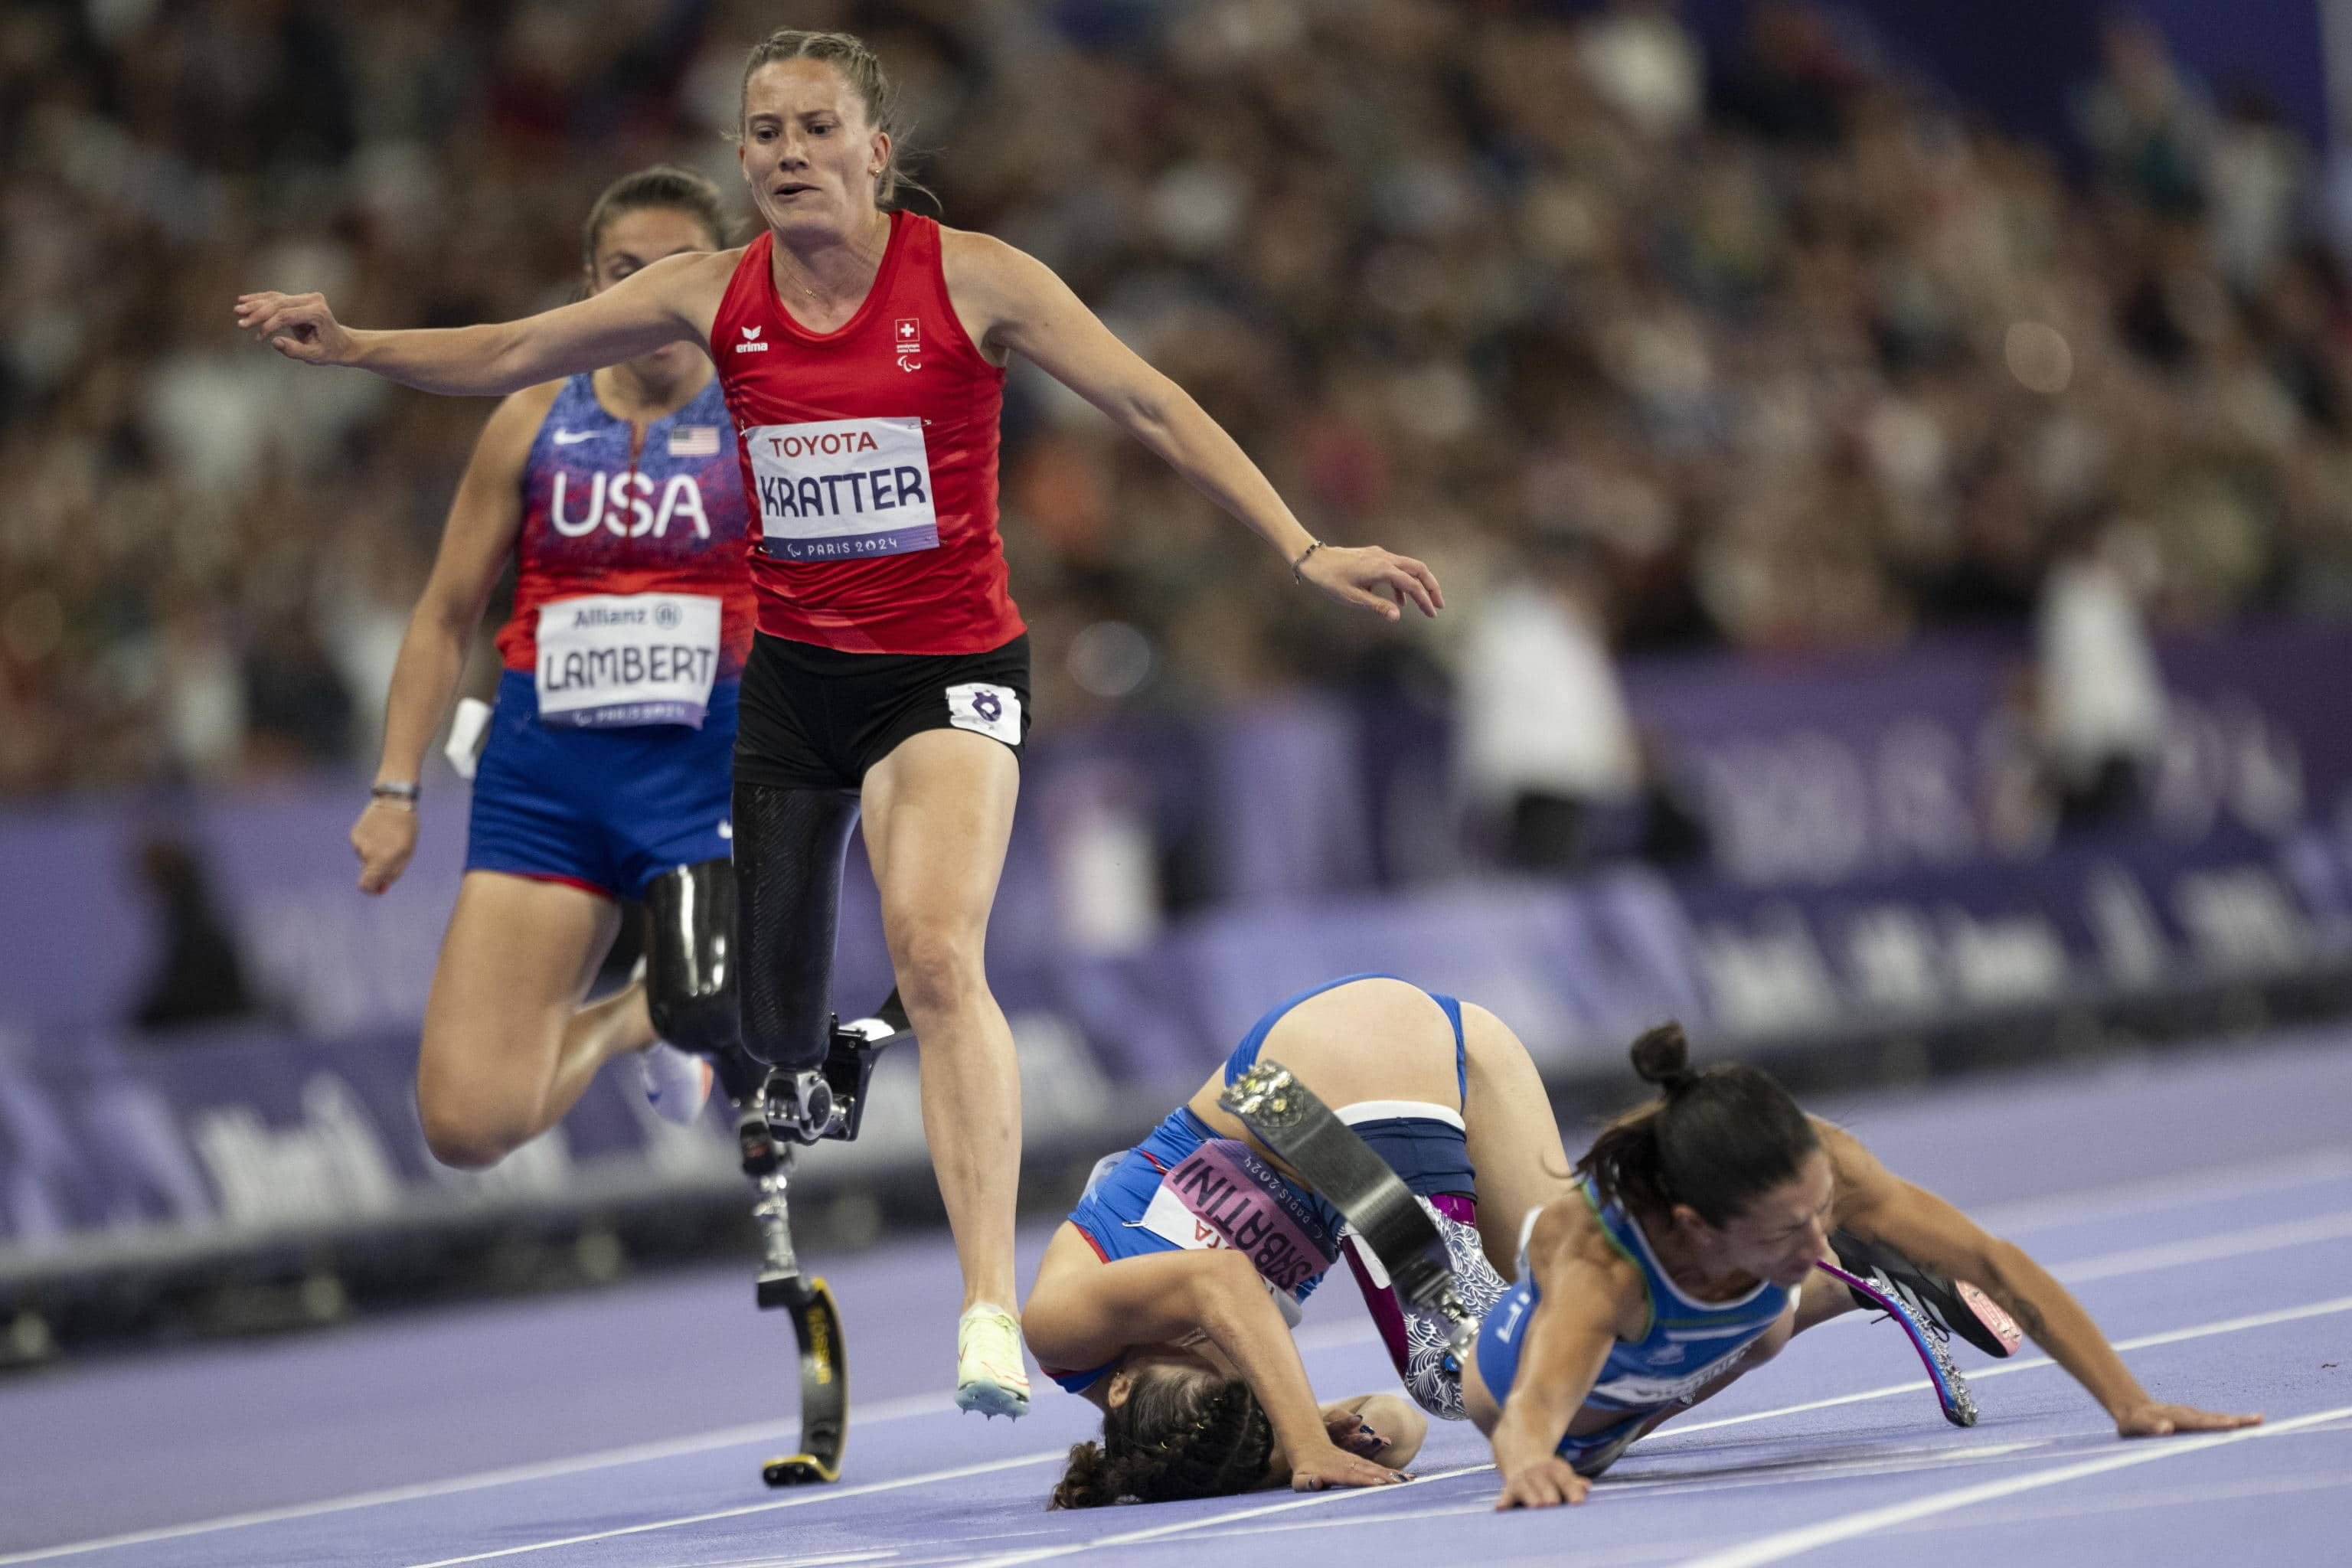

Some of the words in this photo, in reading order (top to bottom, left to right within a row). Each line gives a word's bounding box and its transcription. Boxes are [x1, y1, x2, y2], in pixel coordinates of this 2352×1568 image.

[736, 341, 768, 353] erima
[769, 431, 878, 458] TOYOTA
[551, 471, 710, 539] USA
[760, 466, 926, 518] KRATTER
[808, 542, 851, 556] PARIS
[855, 538, 898, 553] 2024
[575, 607, 648, 628] Allianz
[546, 645, 714, 691] LAMBERT
[1243, 1155, 1280, 1190] 2024
[1172, 1157, 1312, 1290] SABATINI
